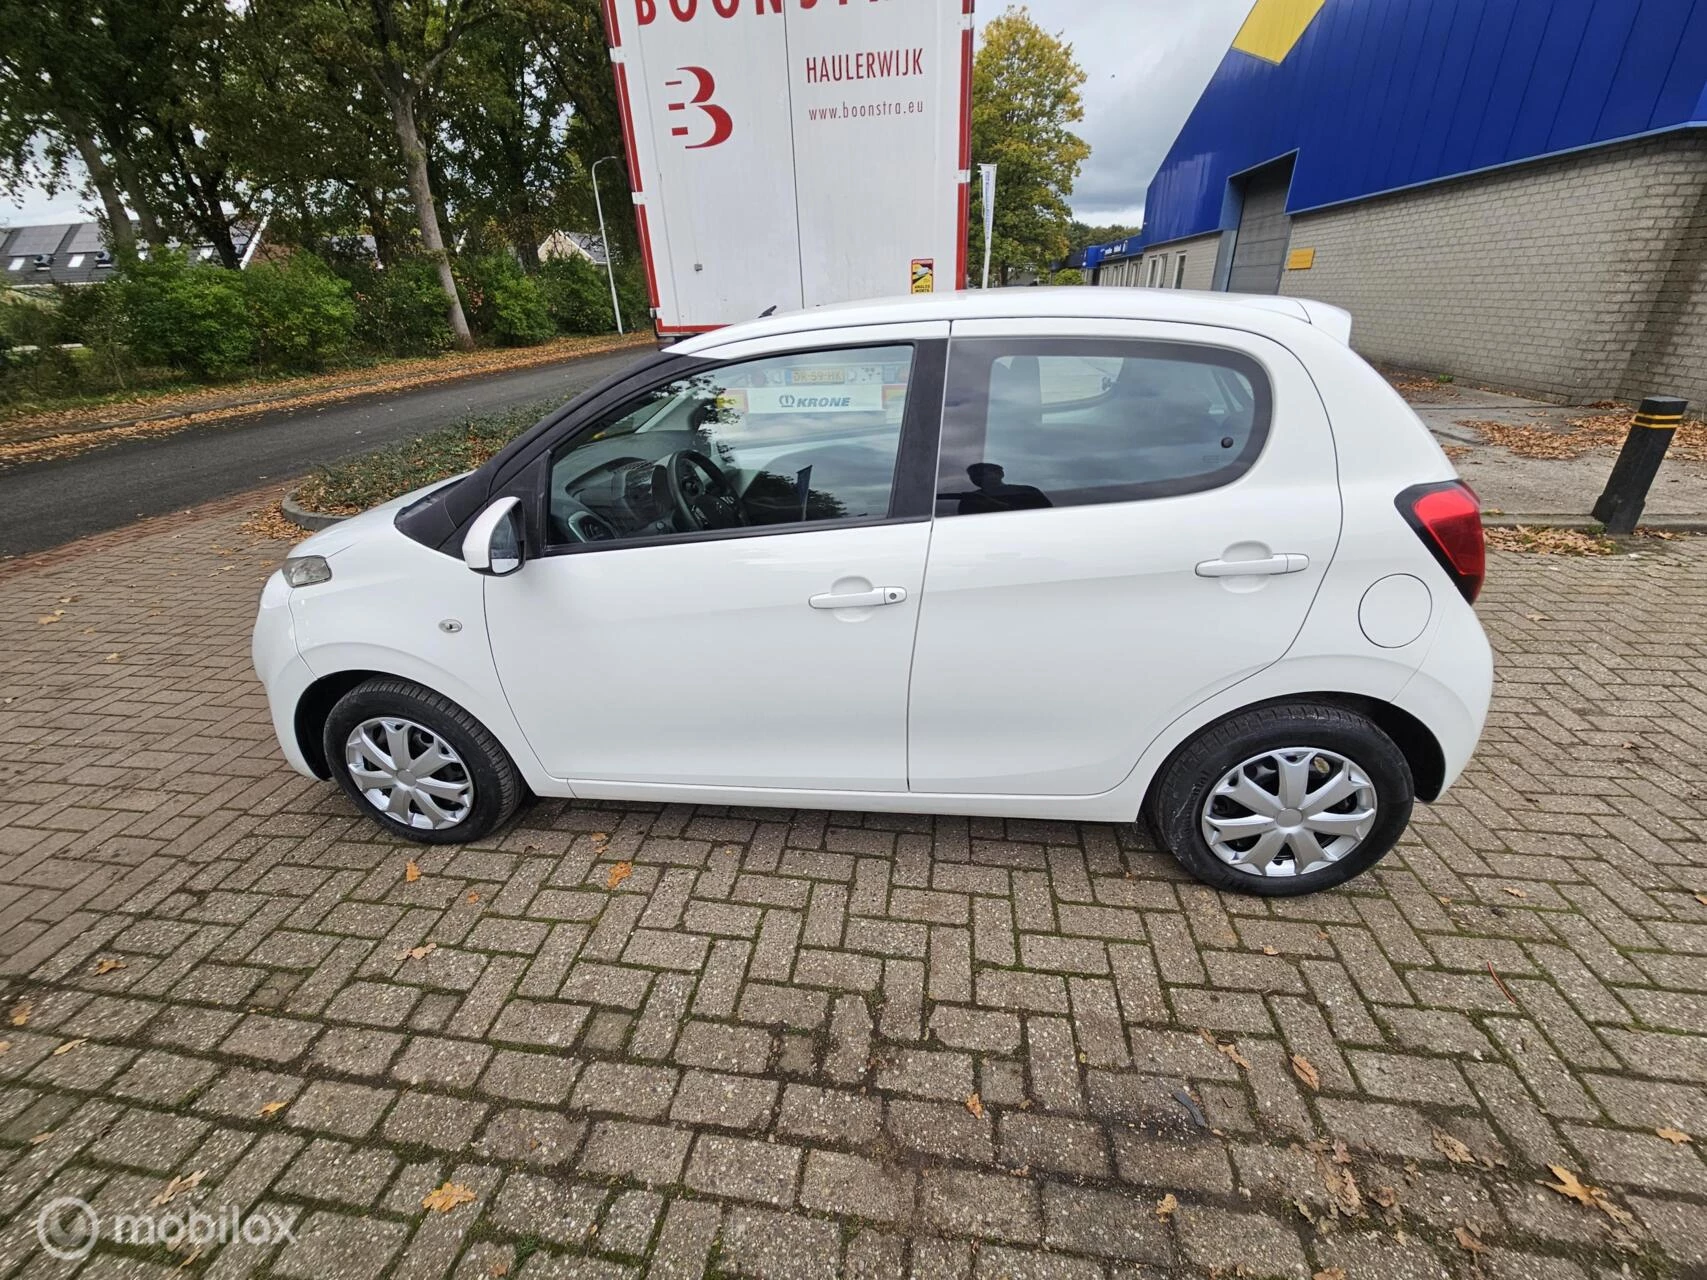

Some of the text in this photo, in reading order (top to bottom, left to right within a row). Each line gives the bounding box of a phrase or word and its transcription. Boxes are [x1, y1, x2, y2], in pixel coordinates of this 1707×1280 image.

[806, 48, 923, 83] HAULERWIJK
[808, 101, 923, 120] www.boonstra.eu
[797, 397, 850, 408] KRONE
